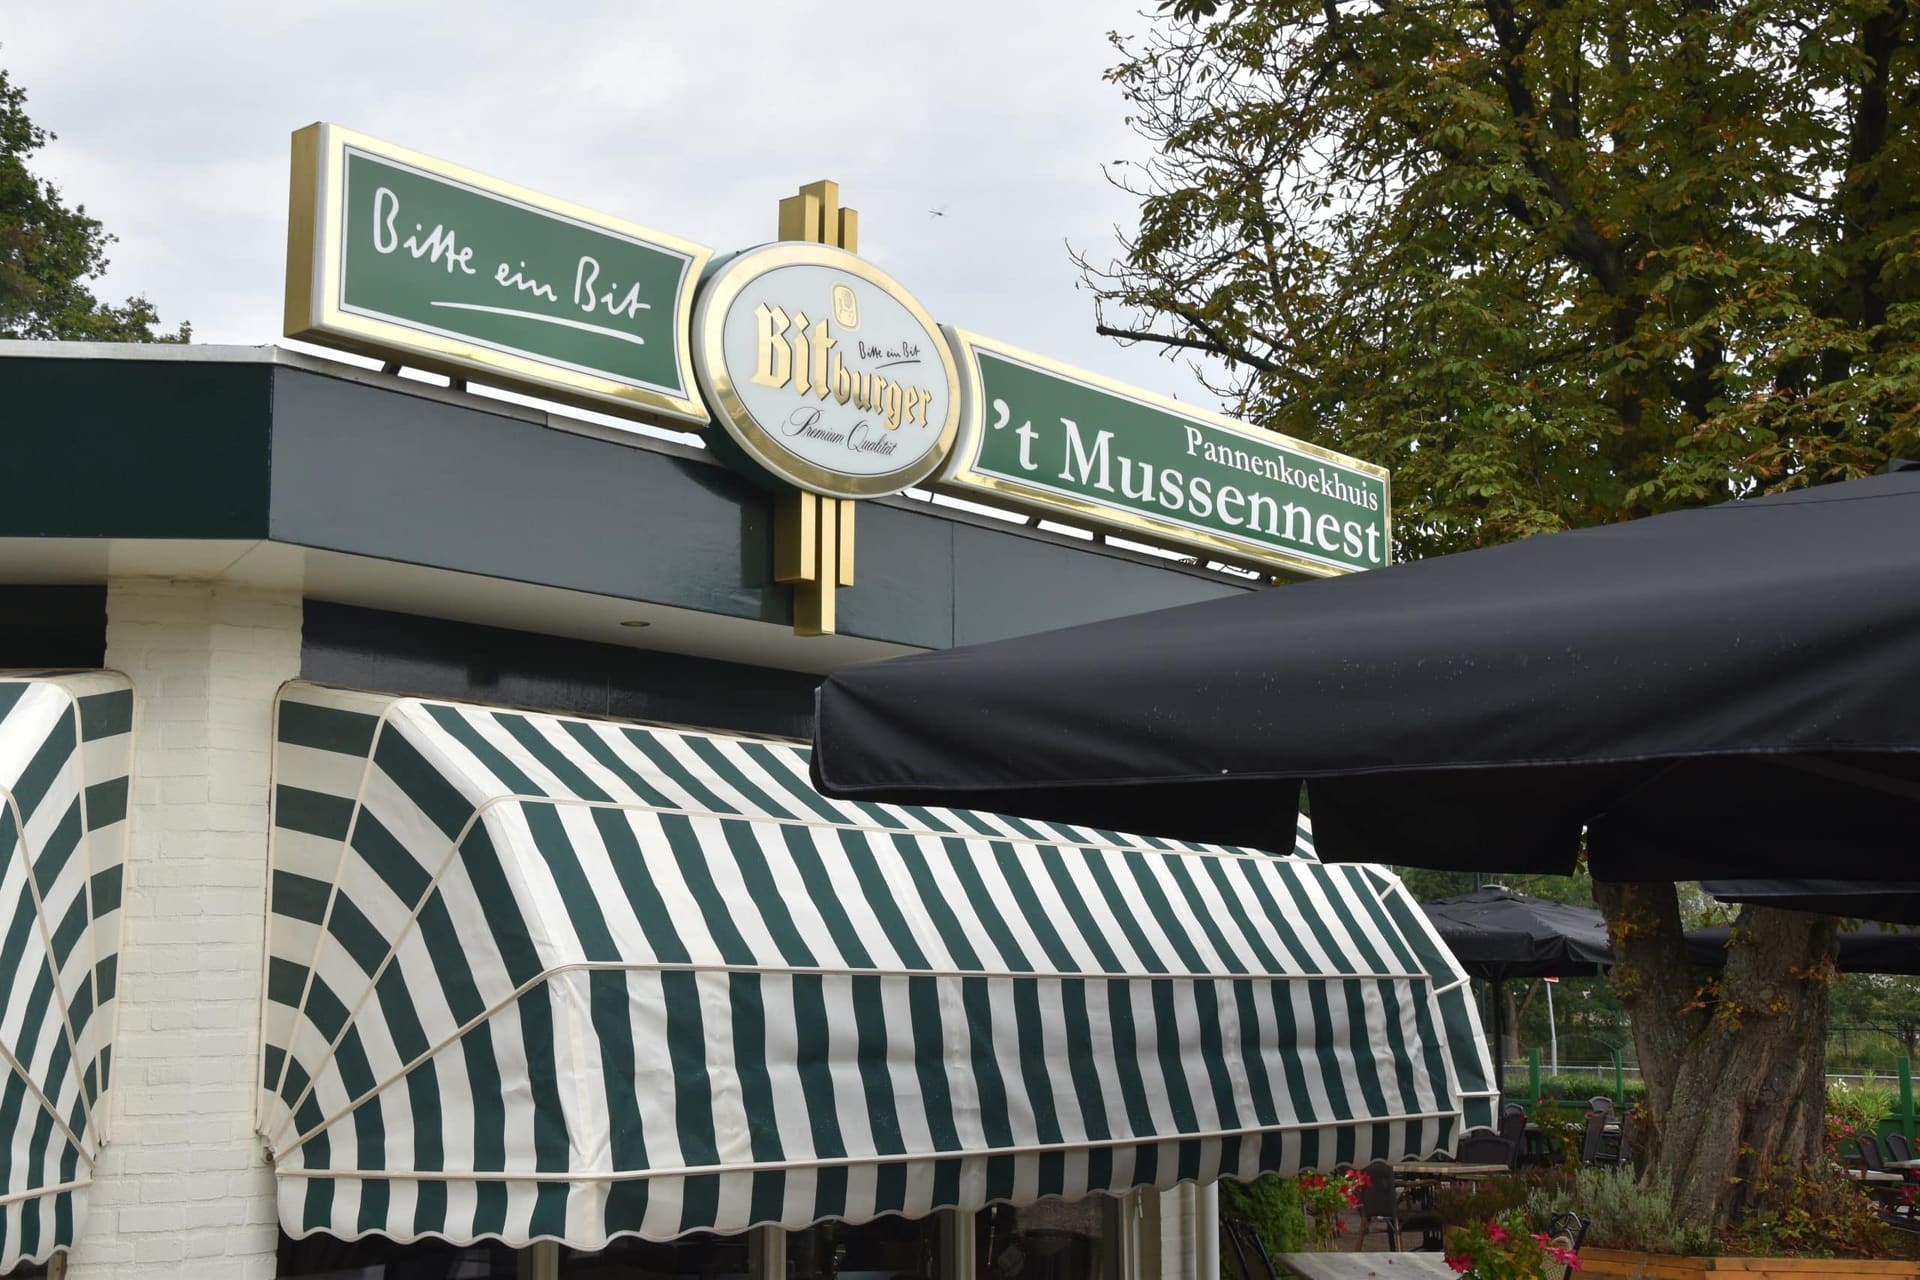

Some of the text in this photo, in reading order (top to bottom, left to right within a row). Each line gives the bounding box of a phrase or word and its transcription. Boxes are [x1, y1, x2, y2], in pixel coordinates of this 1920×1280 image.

[373, 187, 652, 320] Bitte ein Bit
[750, 302, 932, 431] Bitburger
[858, 340, 920, 360] Bitte ein Bit
[782, 406, 897, 456] Premium Qualität
[992, 398, 1381, 564] 't Mussennest
[1184, 424, 1379, 513] Pannenkoekhuis
